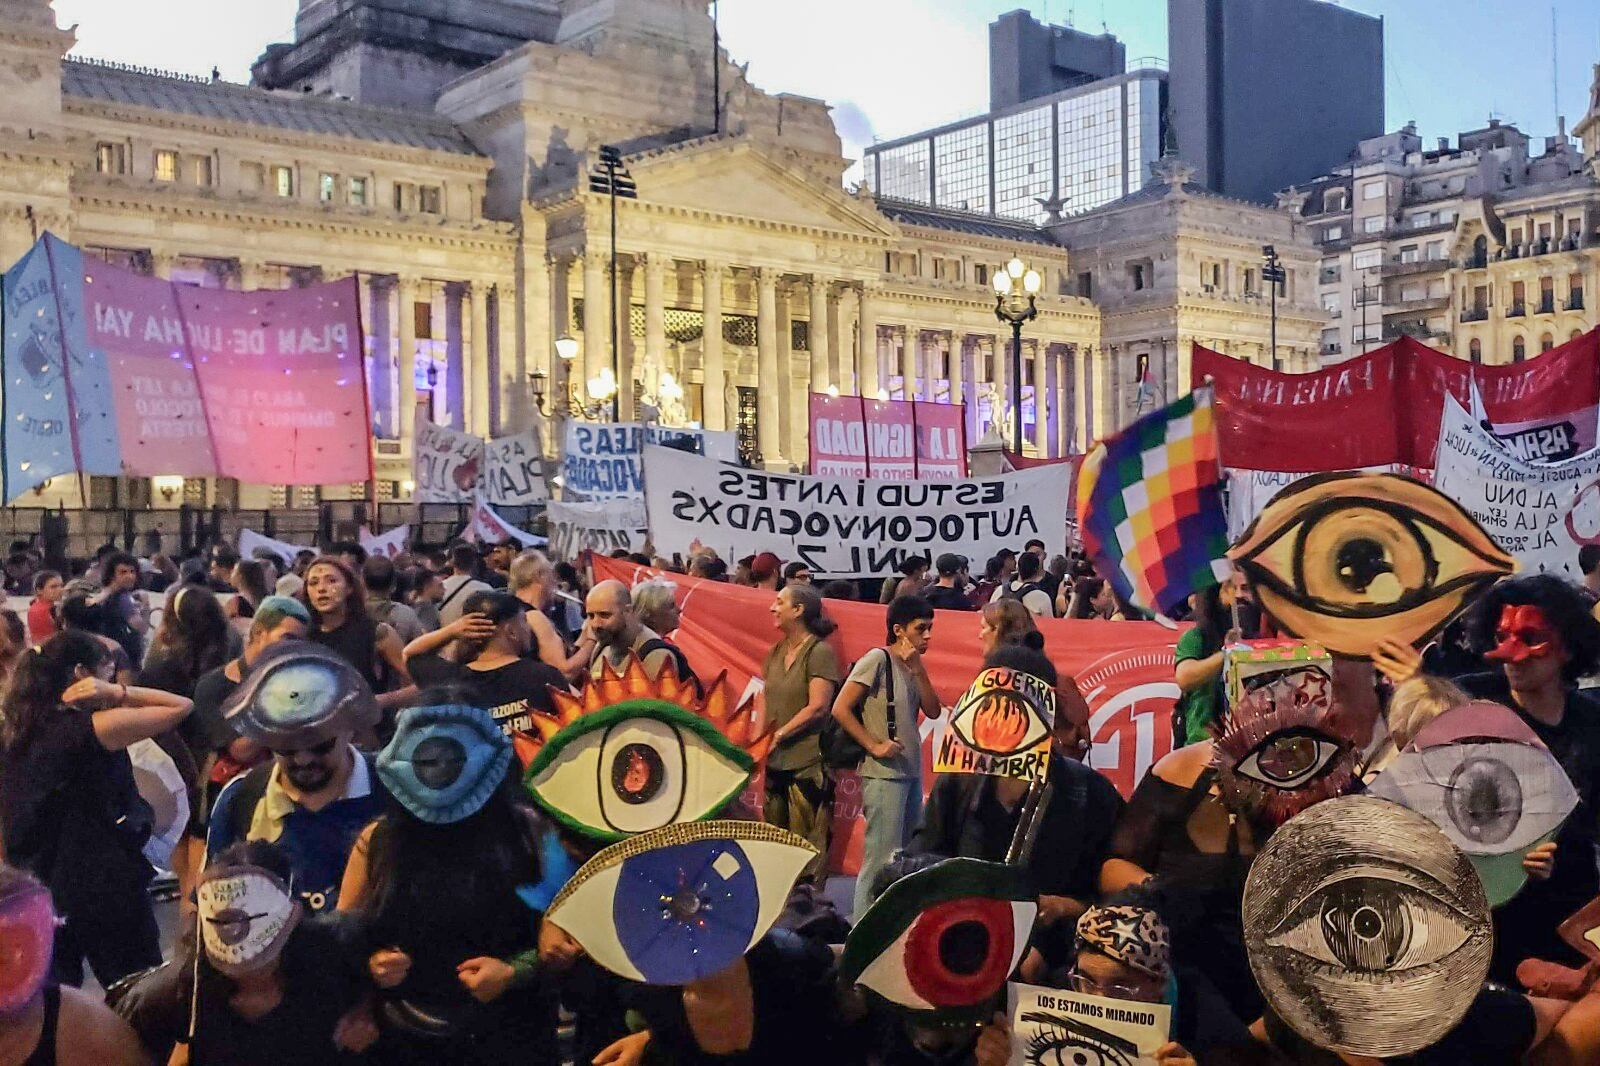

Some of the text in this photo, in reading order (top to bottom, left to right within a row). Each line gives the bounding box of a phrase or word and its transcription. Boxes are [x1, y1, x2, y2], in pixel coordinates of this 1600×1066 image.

[982, 669, 1053, 712] GUERRA
[961, 750, 1049, 780] HAMBRE
[1036, 995, 1155, 1025] LOS ESTAMOS MIRANDO
